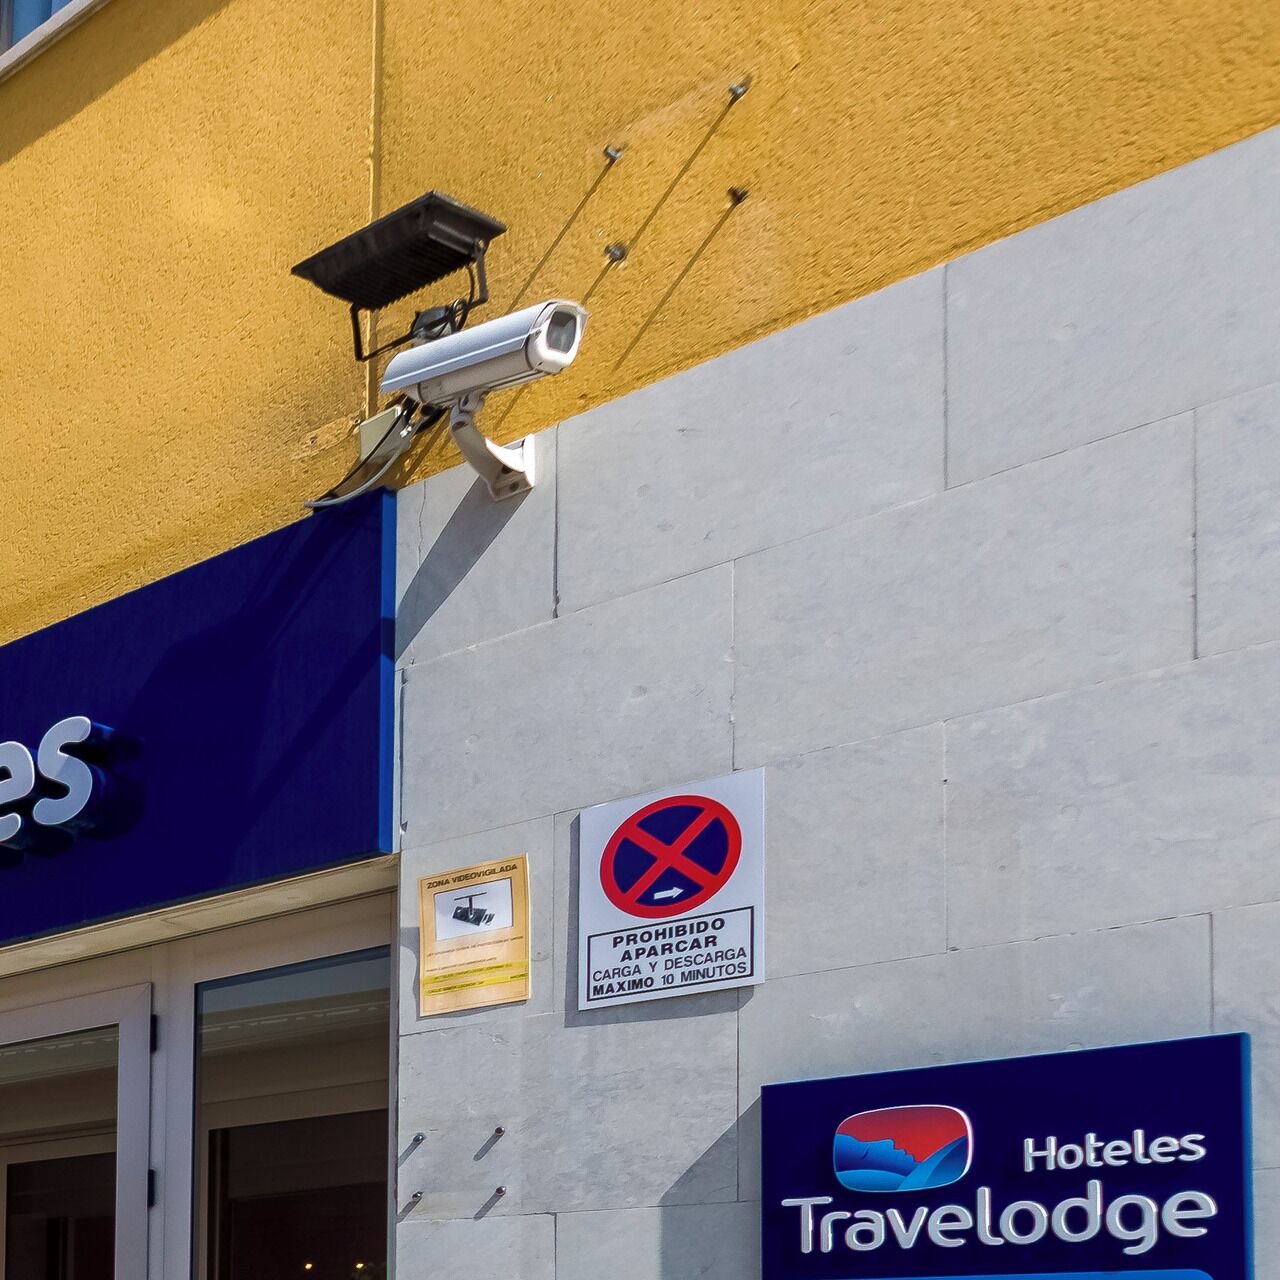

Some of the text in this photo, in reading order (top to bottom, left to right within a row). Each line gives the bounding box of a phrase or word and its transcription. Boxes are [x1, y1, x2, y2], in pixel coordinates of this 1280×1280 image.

[427, 863, 518, 889] ZONA VIDEOVIGILADA
[612, 917, 726, 948] PROHIBIDO
[620, 935, 718, 962] APARCAR
[592, 947, 747, 983] CARGA Y DESCARGA
[592, 961, 747, 997] MAXIMO 10 MINUTOS
[1024, 1128, 1207, 1172] Hoteles
[781, 1179, 1218, 1256] Travelodge
